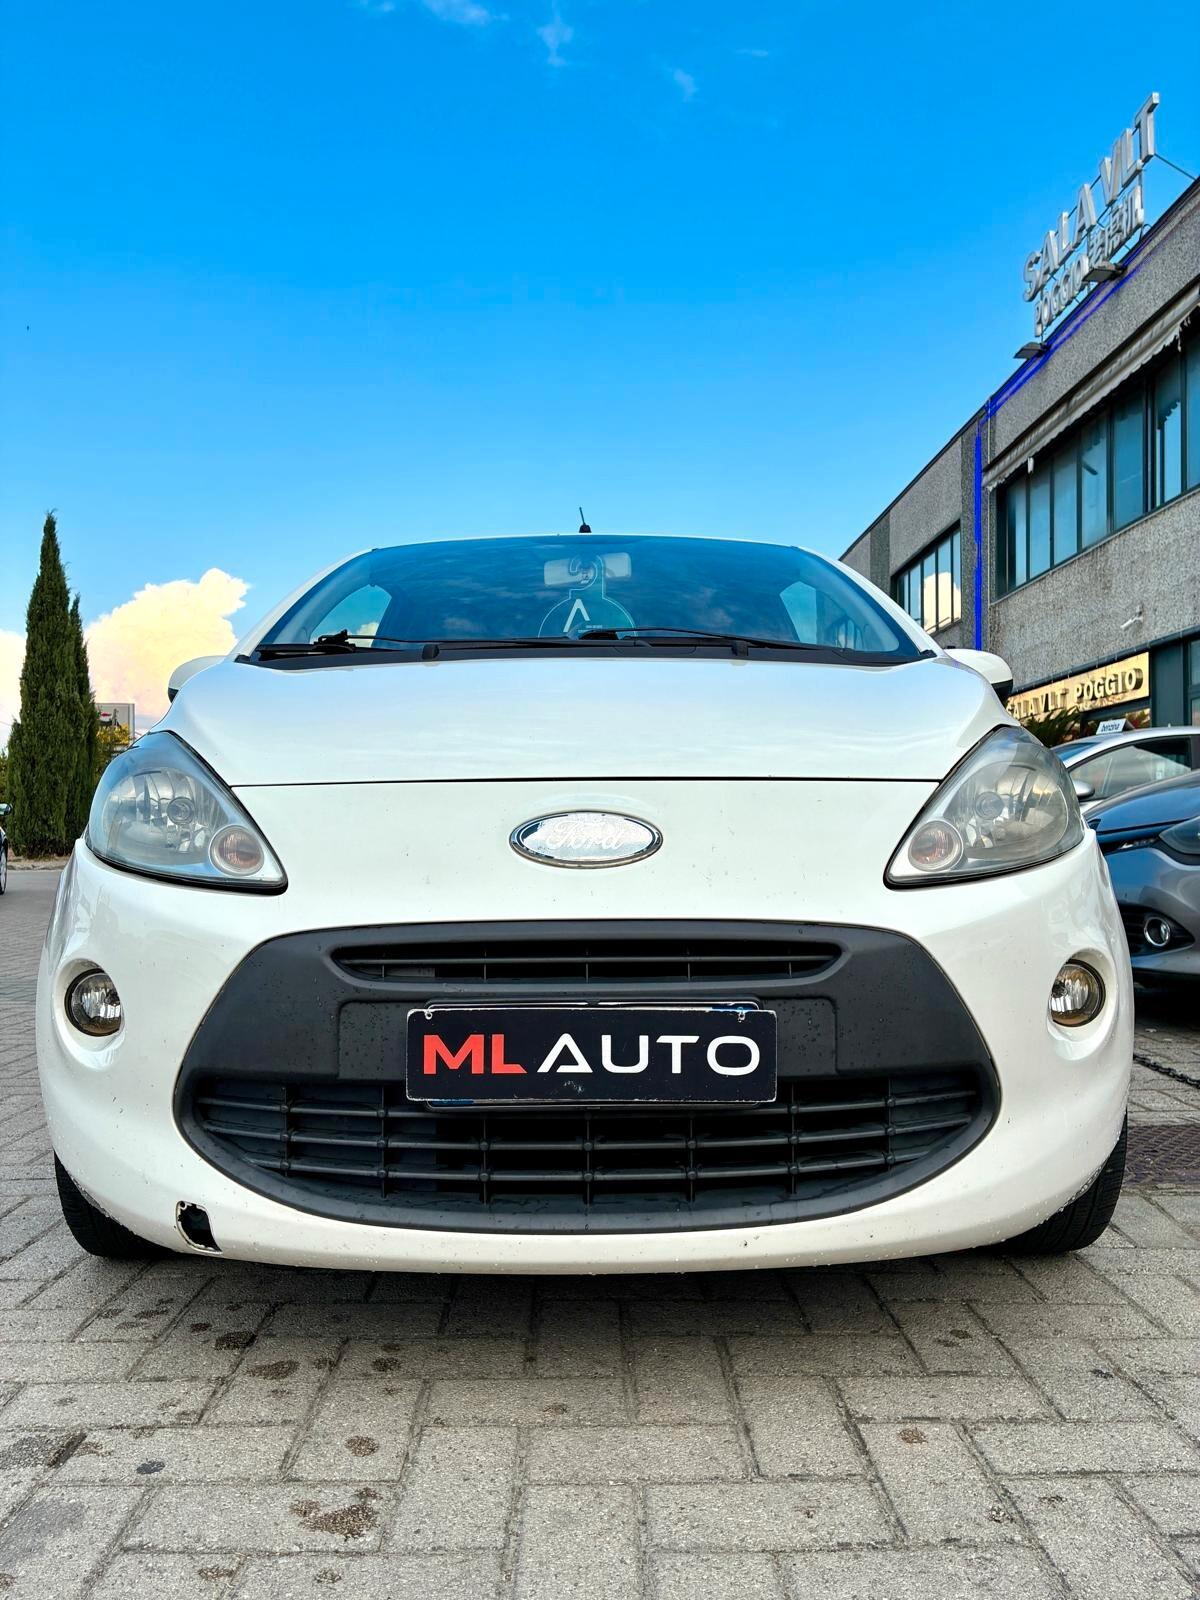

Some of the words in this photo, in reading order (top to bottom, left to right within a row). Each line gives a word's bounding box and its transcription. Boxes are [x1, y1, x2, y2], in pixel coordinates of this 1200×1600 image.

[1023, 184, 1096, 302] SALA
[1101, 92, 1159, 206] VLT
[1034, 255, 1090, 337] POGGIO
[1074, 667, 1143, 703] POGGIO
[545, 820, 625, 850] Ford
